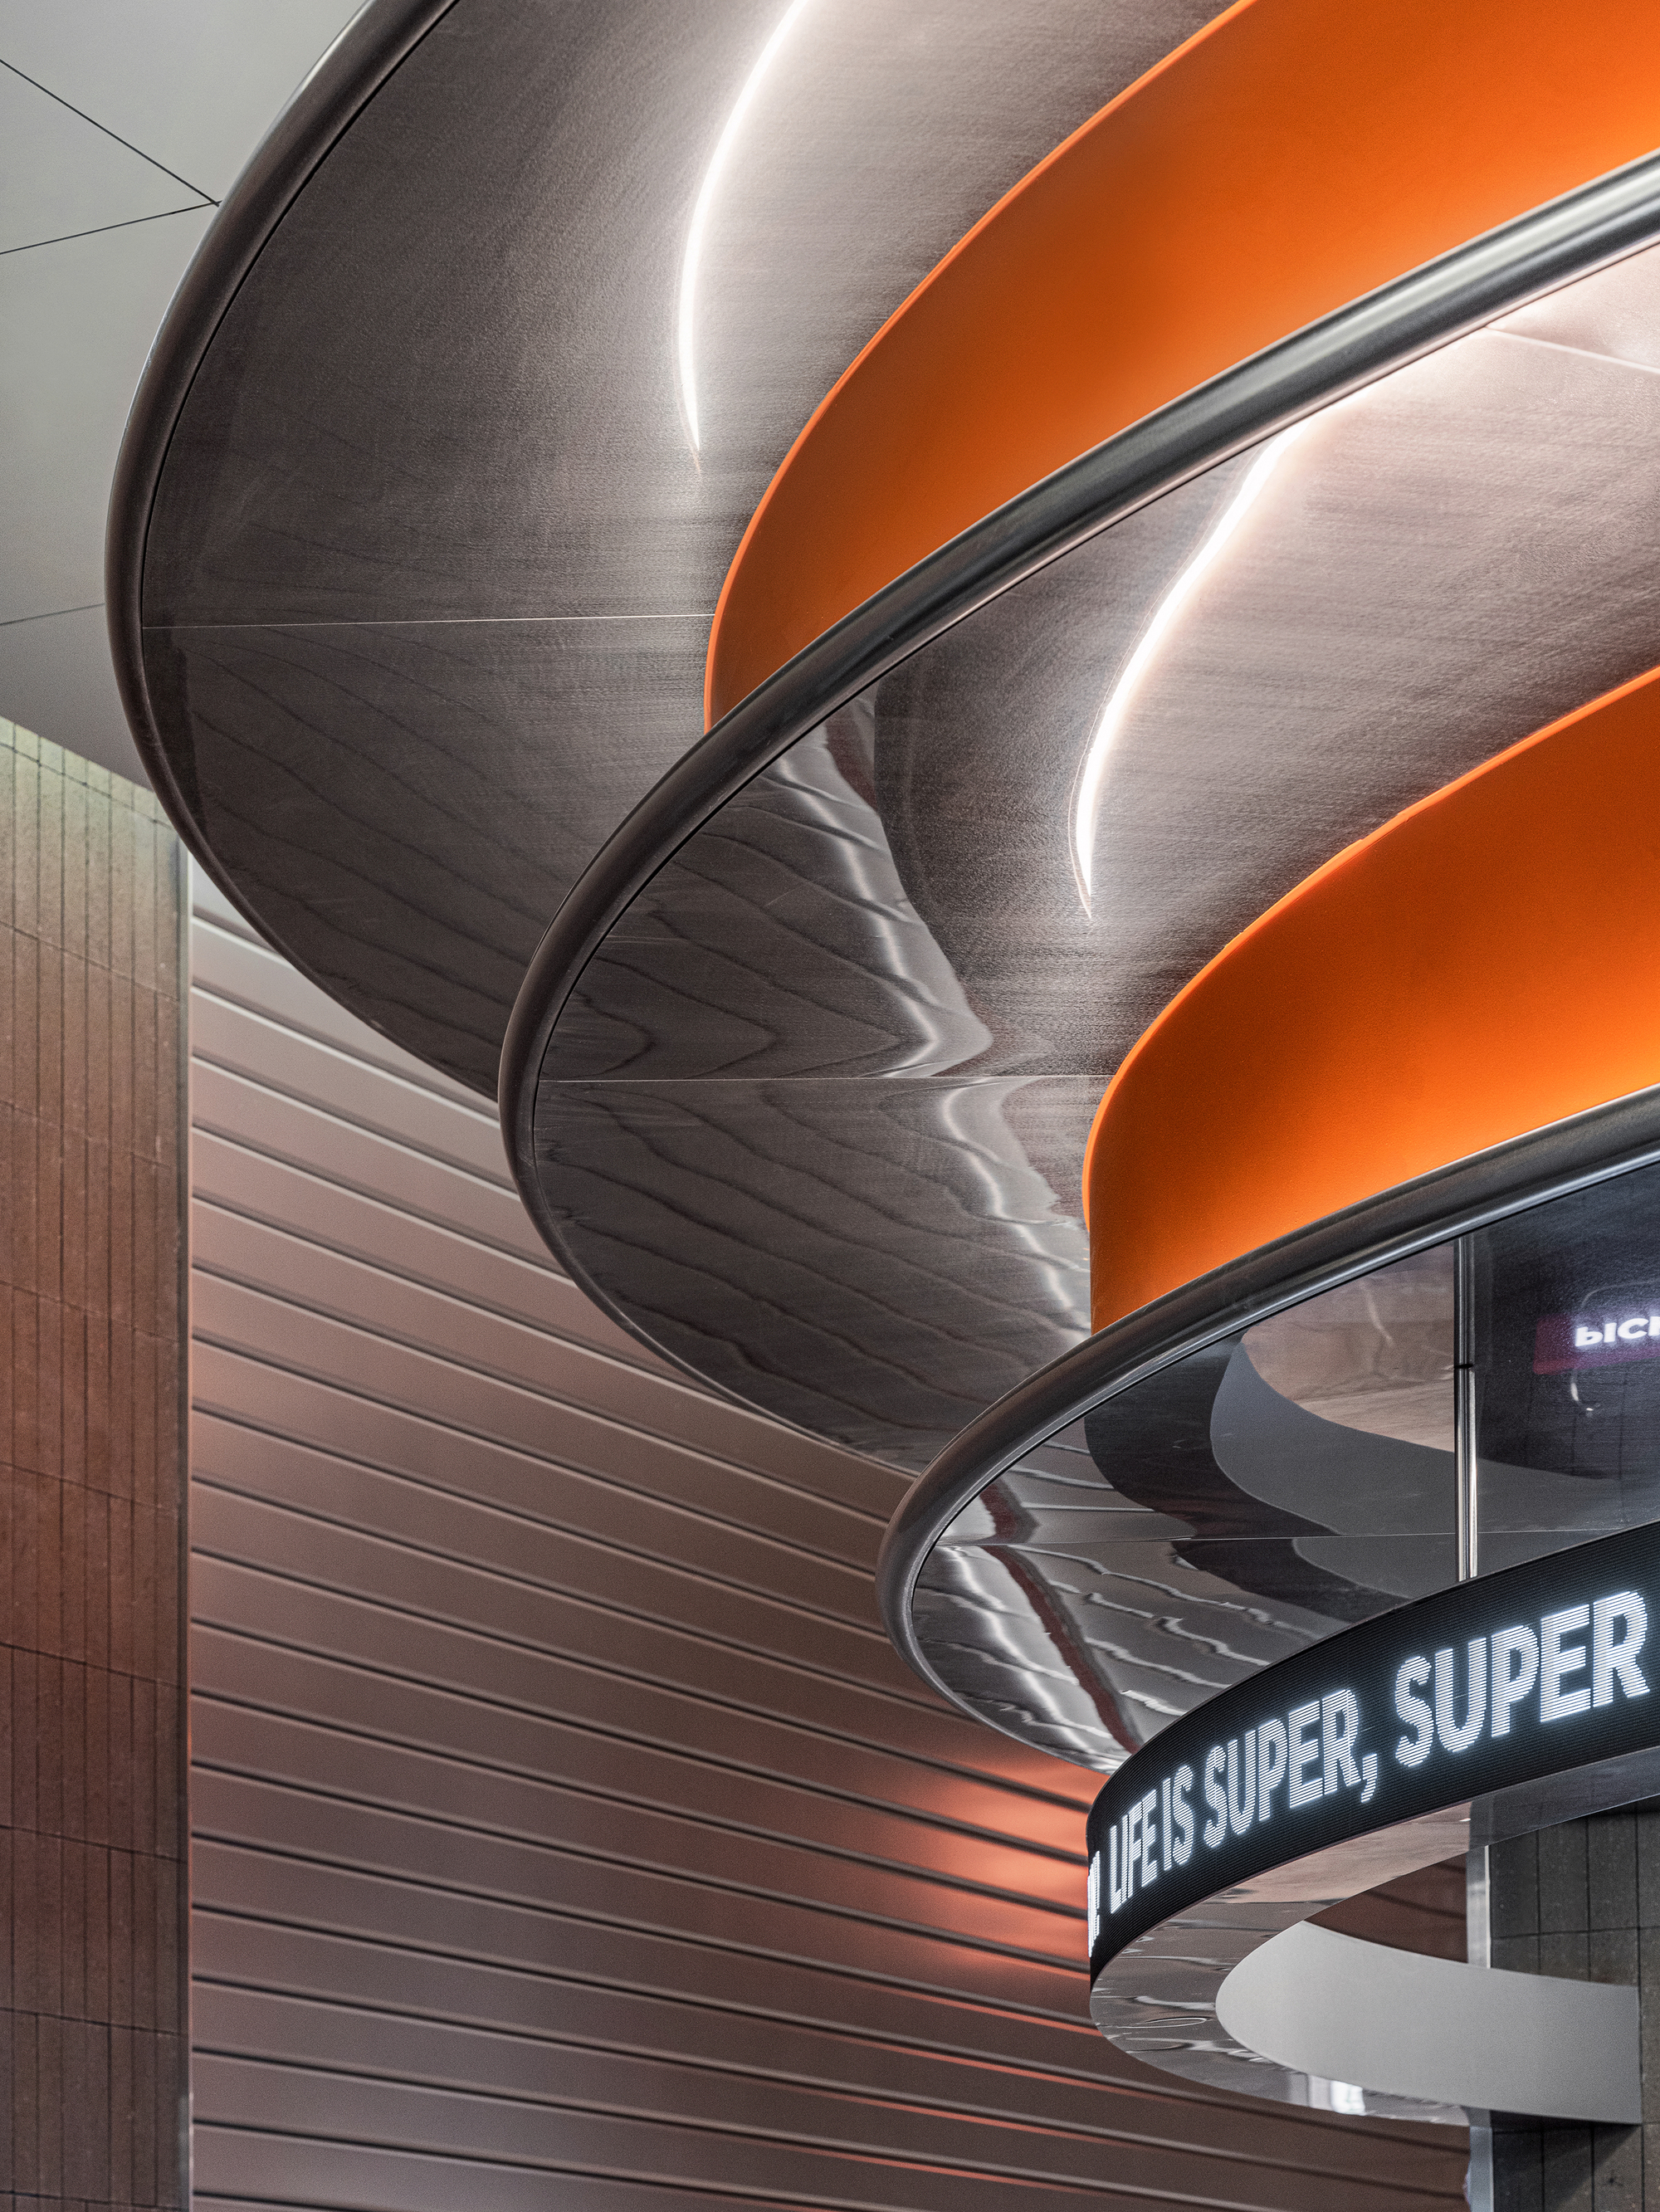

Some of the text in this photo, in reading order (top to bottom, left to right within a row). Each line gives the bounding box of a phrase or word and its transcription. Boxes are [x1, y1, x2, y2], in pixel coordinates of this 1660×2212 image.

[1111, 1790, 1158, 1913] LIFE
[1162, 1765, 1194, 1872] IS
[1204, 1688, 1379, 1848] SUPER,
[1395, 1590, 1650, 1768] SUPER
